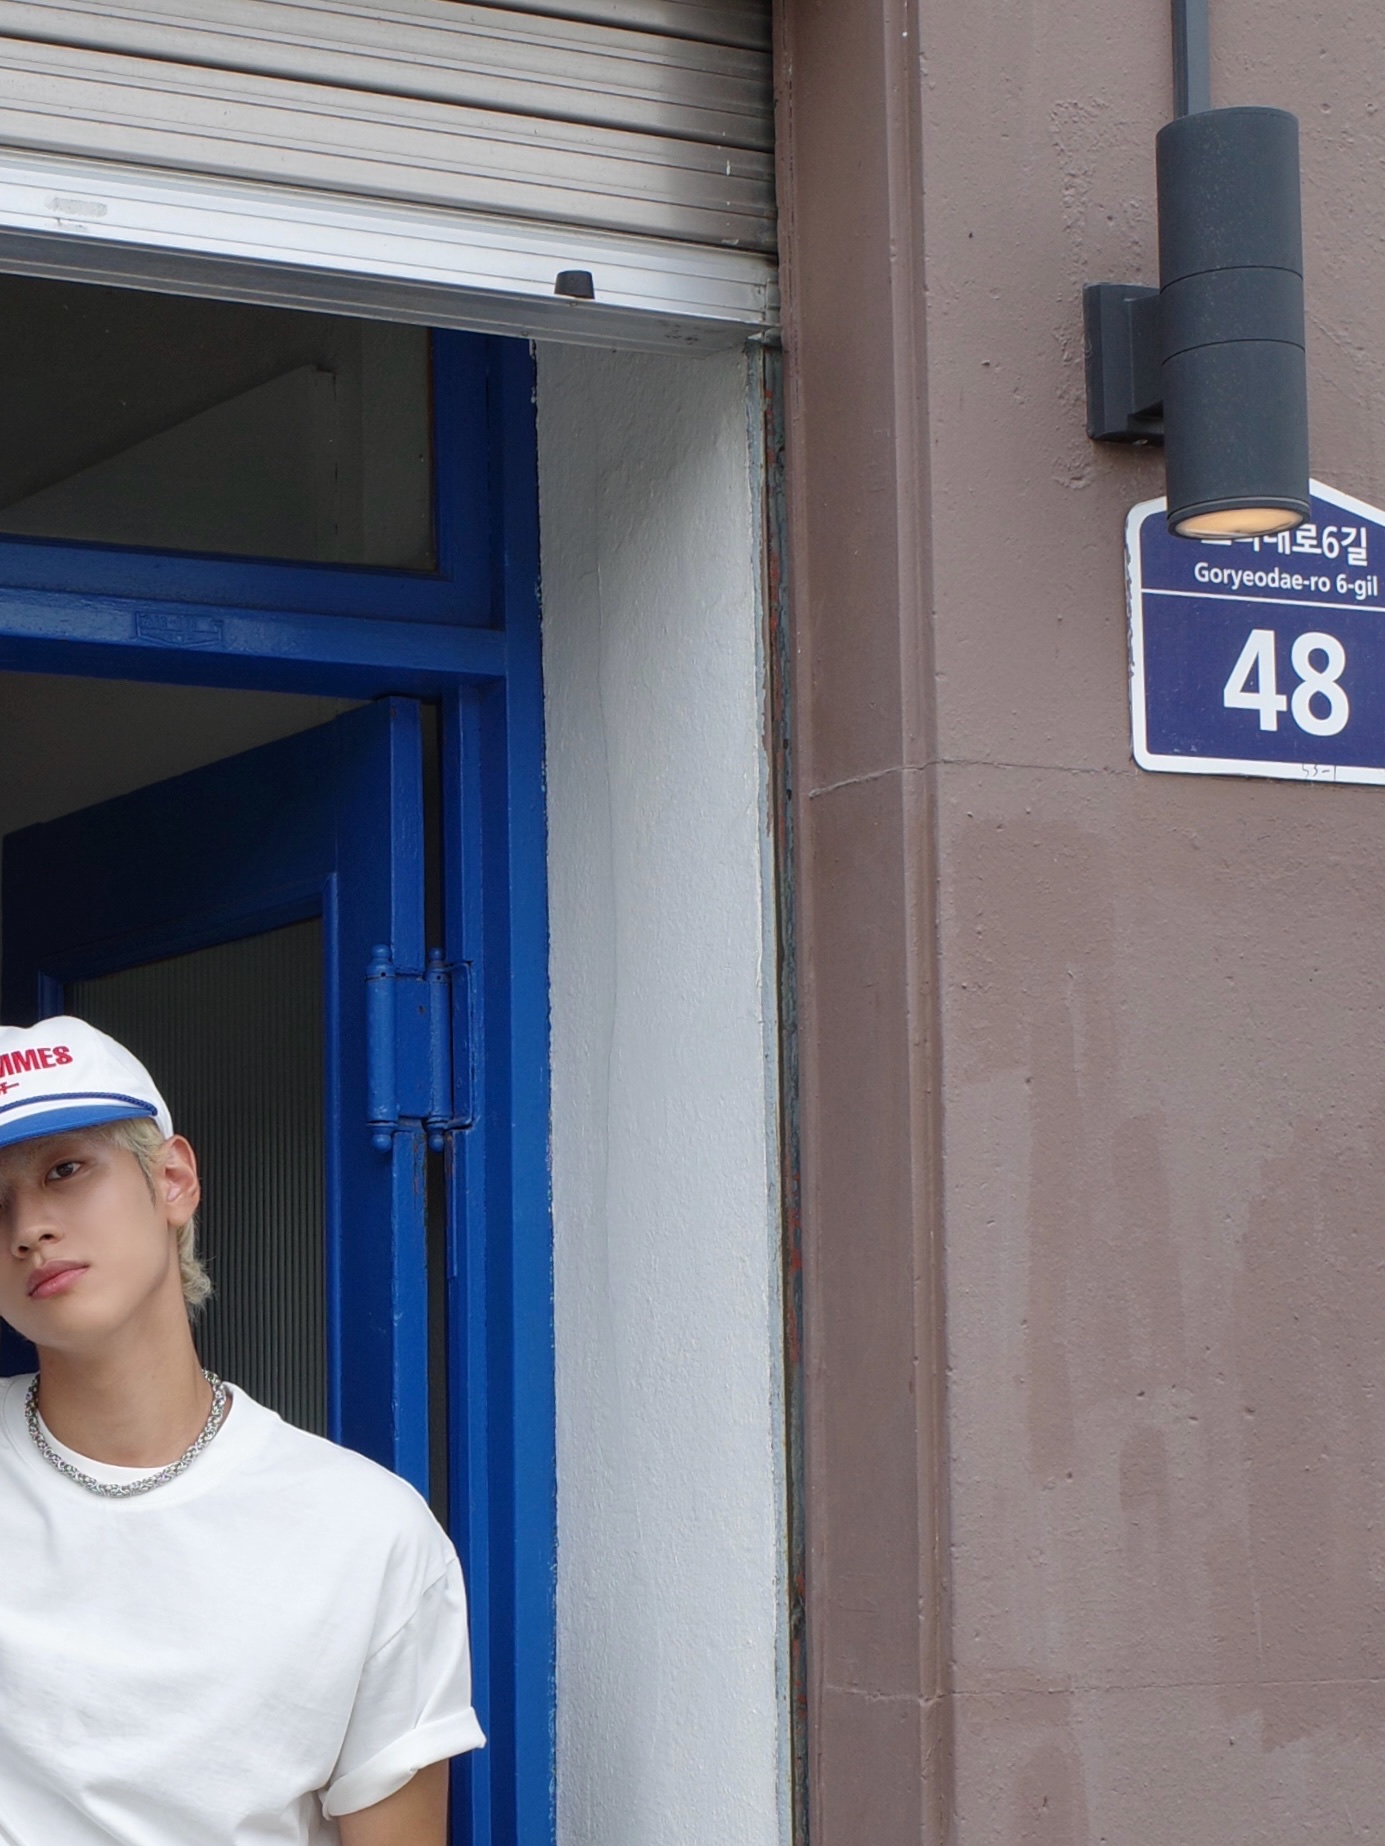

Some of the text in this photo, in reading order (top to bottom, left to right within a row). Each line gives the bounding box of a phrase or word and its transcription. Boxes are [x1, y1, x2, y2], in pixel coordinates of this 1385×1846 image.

[1201, 523, 1368, 566] 대로6길
[1194, 562, 1379, 600] Goryeodae-ro 6-gil
[1224, 629, 1350, 736] 48
